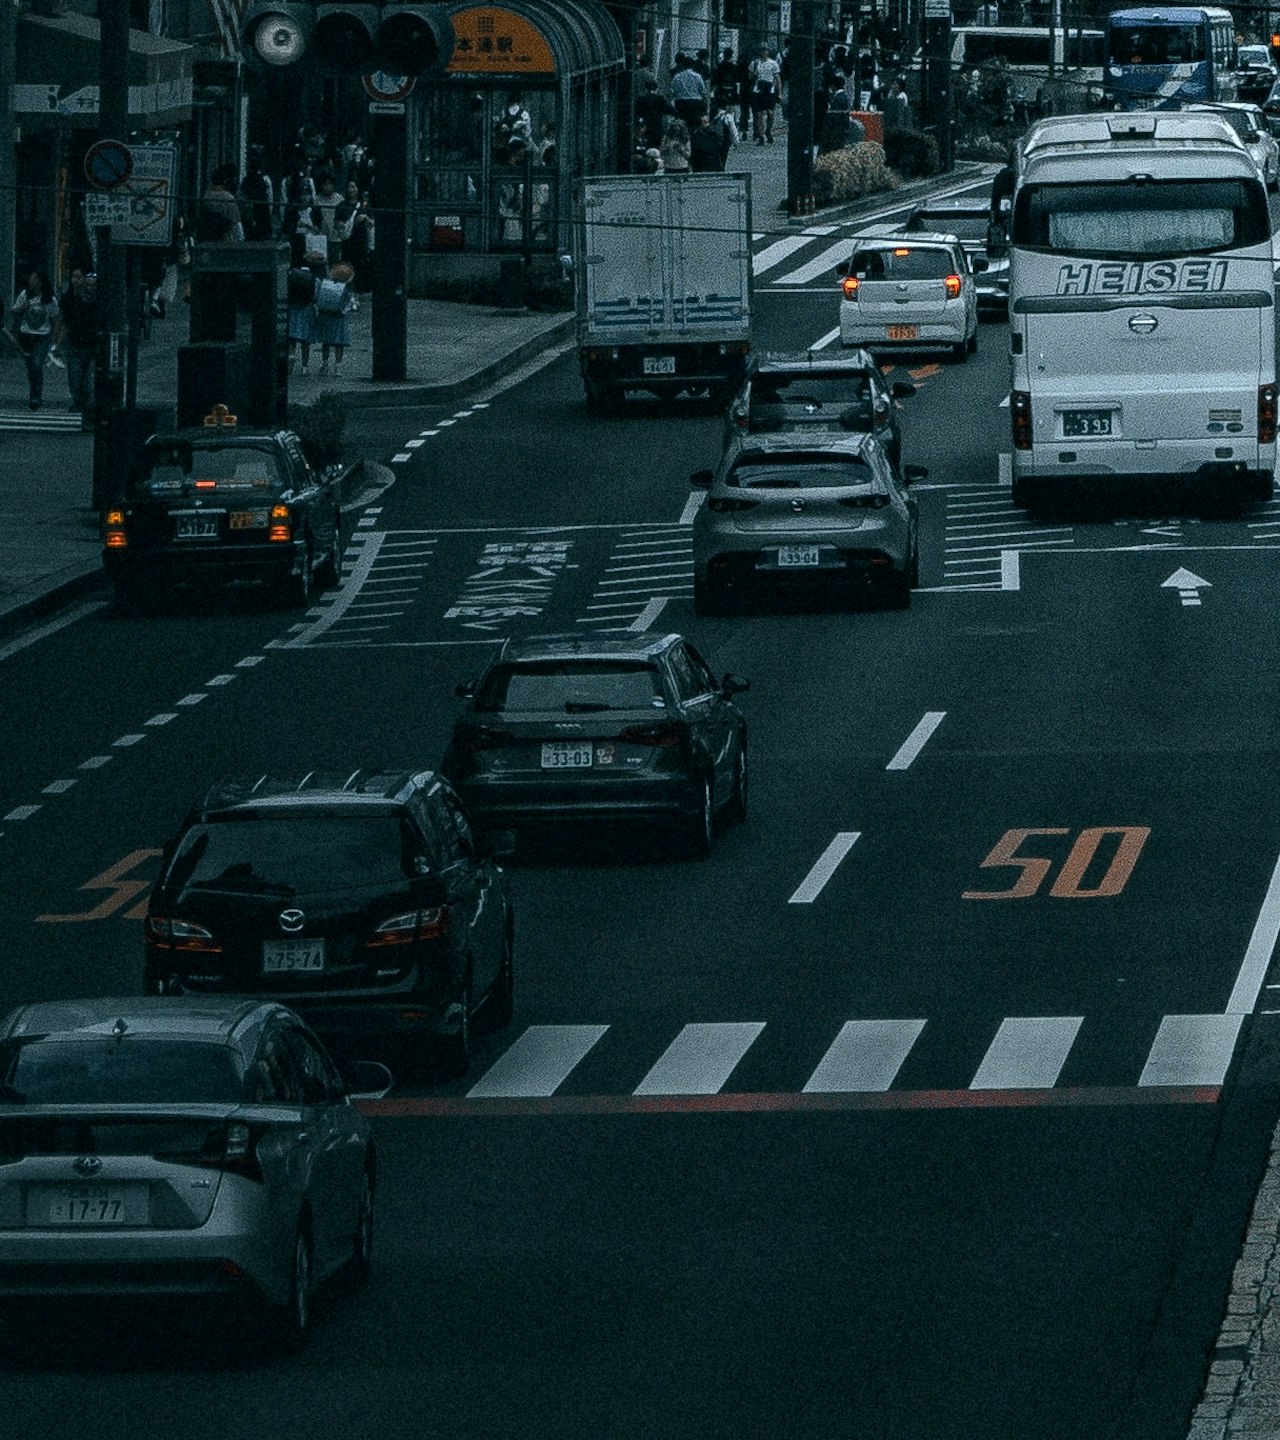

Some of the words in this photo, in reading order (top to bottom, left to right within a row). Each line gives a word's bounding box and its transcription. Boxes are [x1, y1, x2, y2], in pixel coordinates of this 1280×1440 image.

[1057, 262, 1229, 296] HEISEI
[961, 827, 1151, 899] 50
[275, 950, 322, 968] 75-74
[68, 1200, 122, 1219] 17-77
